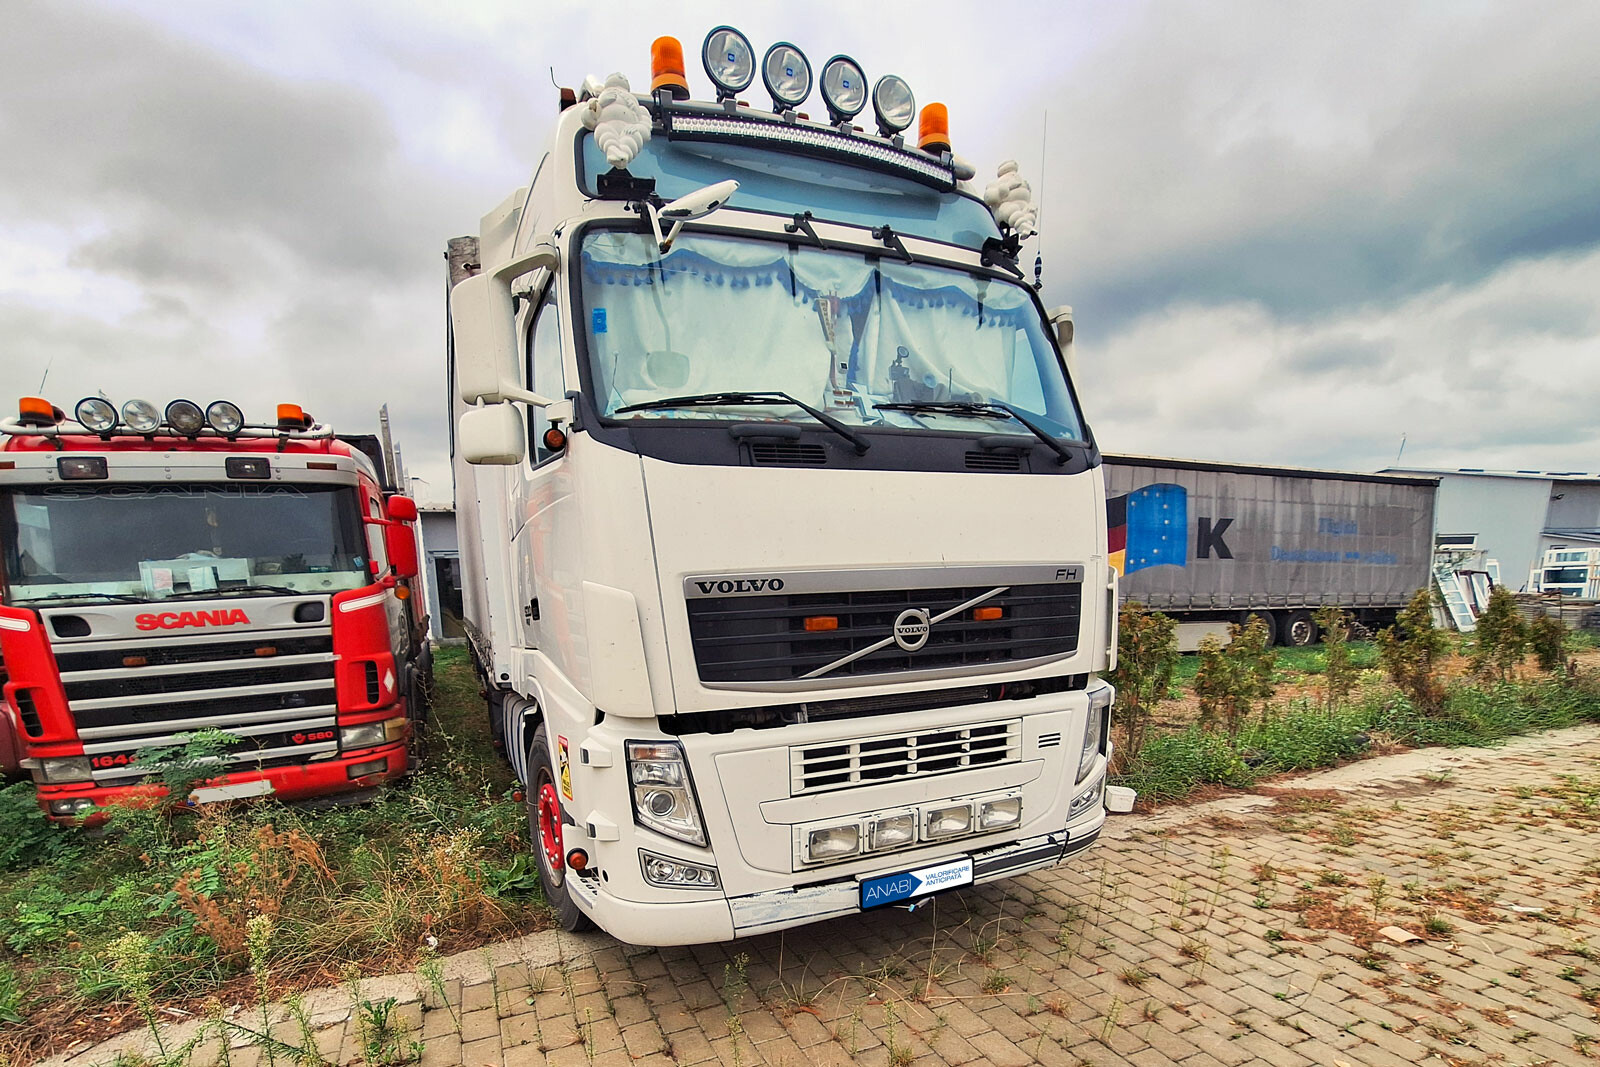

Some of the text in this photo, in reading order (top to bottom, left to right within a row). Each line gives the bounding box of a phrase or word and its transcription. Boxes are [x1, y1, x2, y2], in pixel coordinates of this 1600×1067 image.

[43, 484, 308, 501] SCANIA
[1197, 516, 1235, 559] K
[1055, 569, 1077, 580] FH
[694, 579, 785, 594] VOLVO
[135, 609, 251, 630] SCANIA
[307, 731, 334, 740] 580
[926, 865, 969, 880] VALORIFICARE
[866, 879, 912, 901] ANABI
